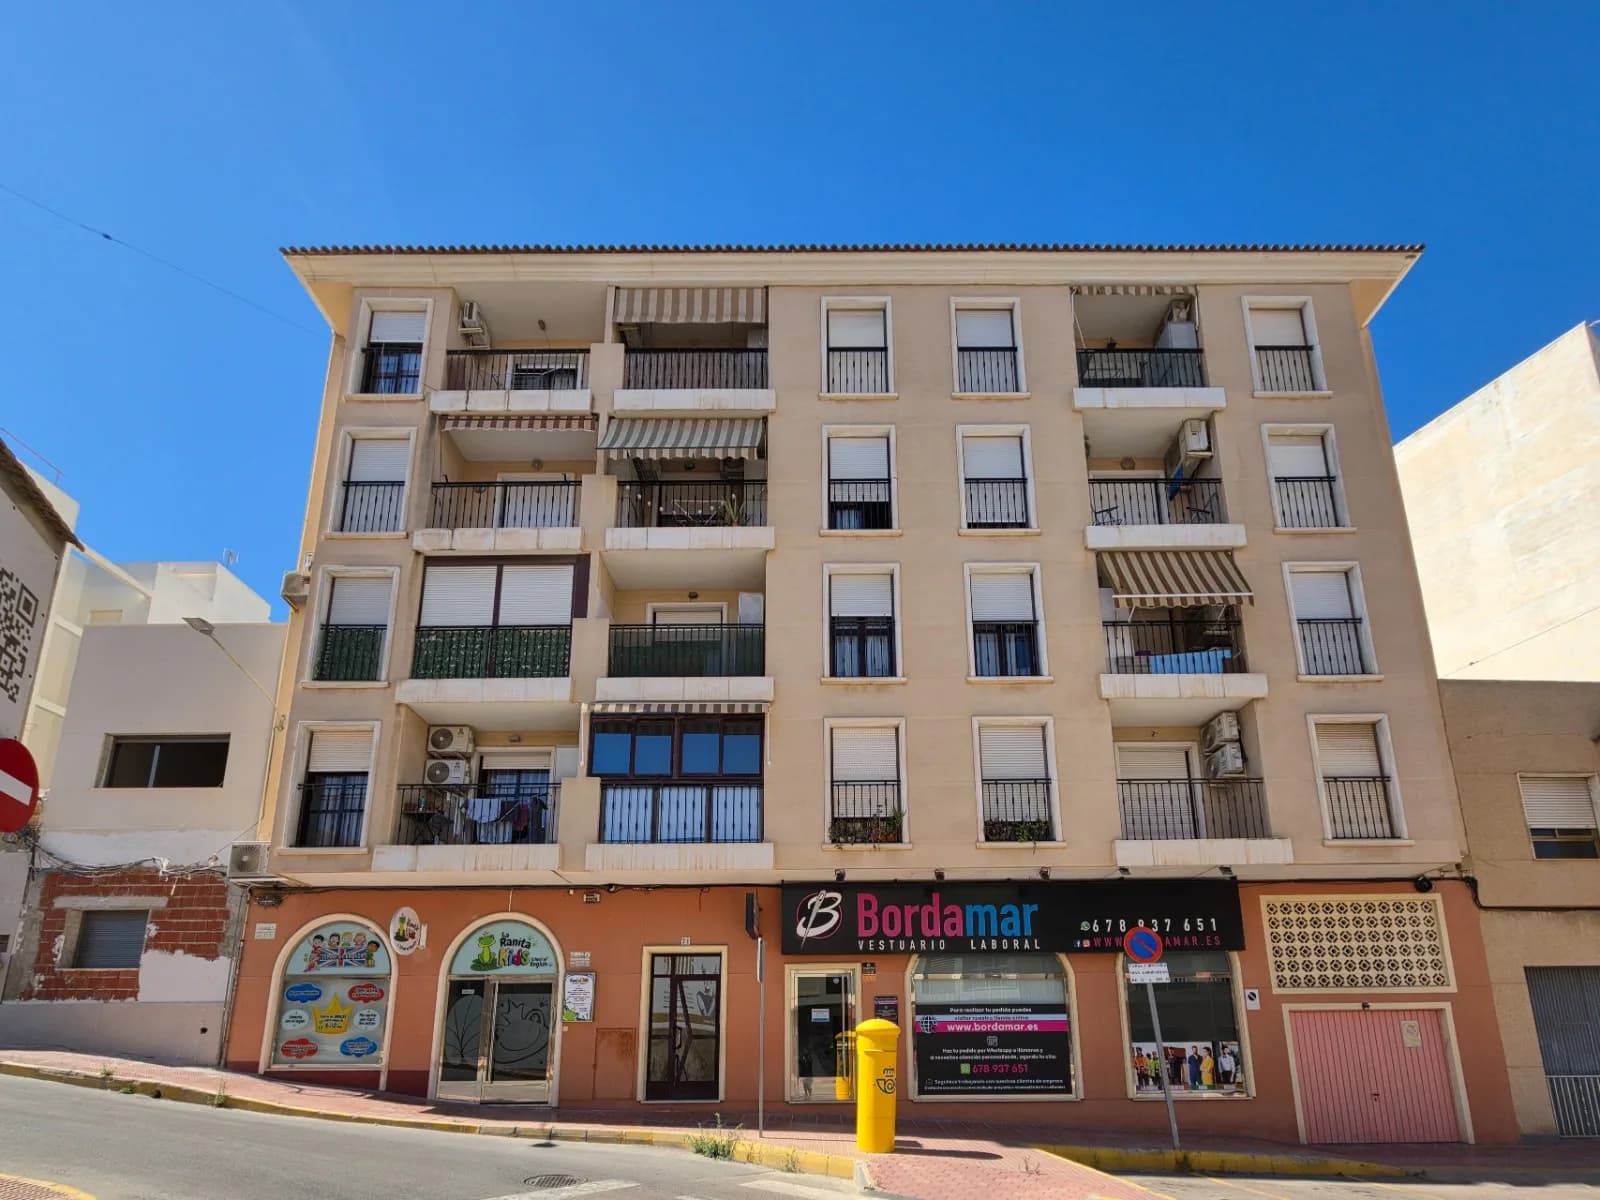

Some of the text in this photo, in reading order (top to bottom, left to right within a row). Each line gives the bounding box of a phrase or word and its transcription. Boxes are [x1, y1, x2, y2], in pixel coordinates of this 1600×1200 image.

[796, 890, 843, 940] B
[856, 892, 1039, 938] Bordamar
[1092, 918, 1126, 933] 678
[1183, 918, 1217, 932] 651
[500, 937, 531, 949] Ranita
[857, 938, 1041, 951] VESTUARIO LABORAL
[1093, 935, 1221, 948] WWWAMAR.ES
[498, 947, 530, 967] Kids
[946, 1022, 1038, 1032] www.bordamar.es
[972, 1063, 1028, 1073] 678 937 651
